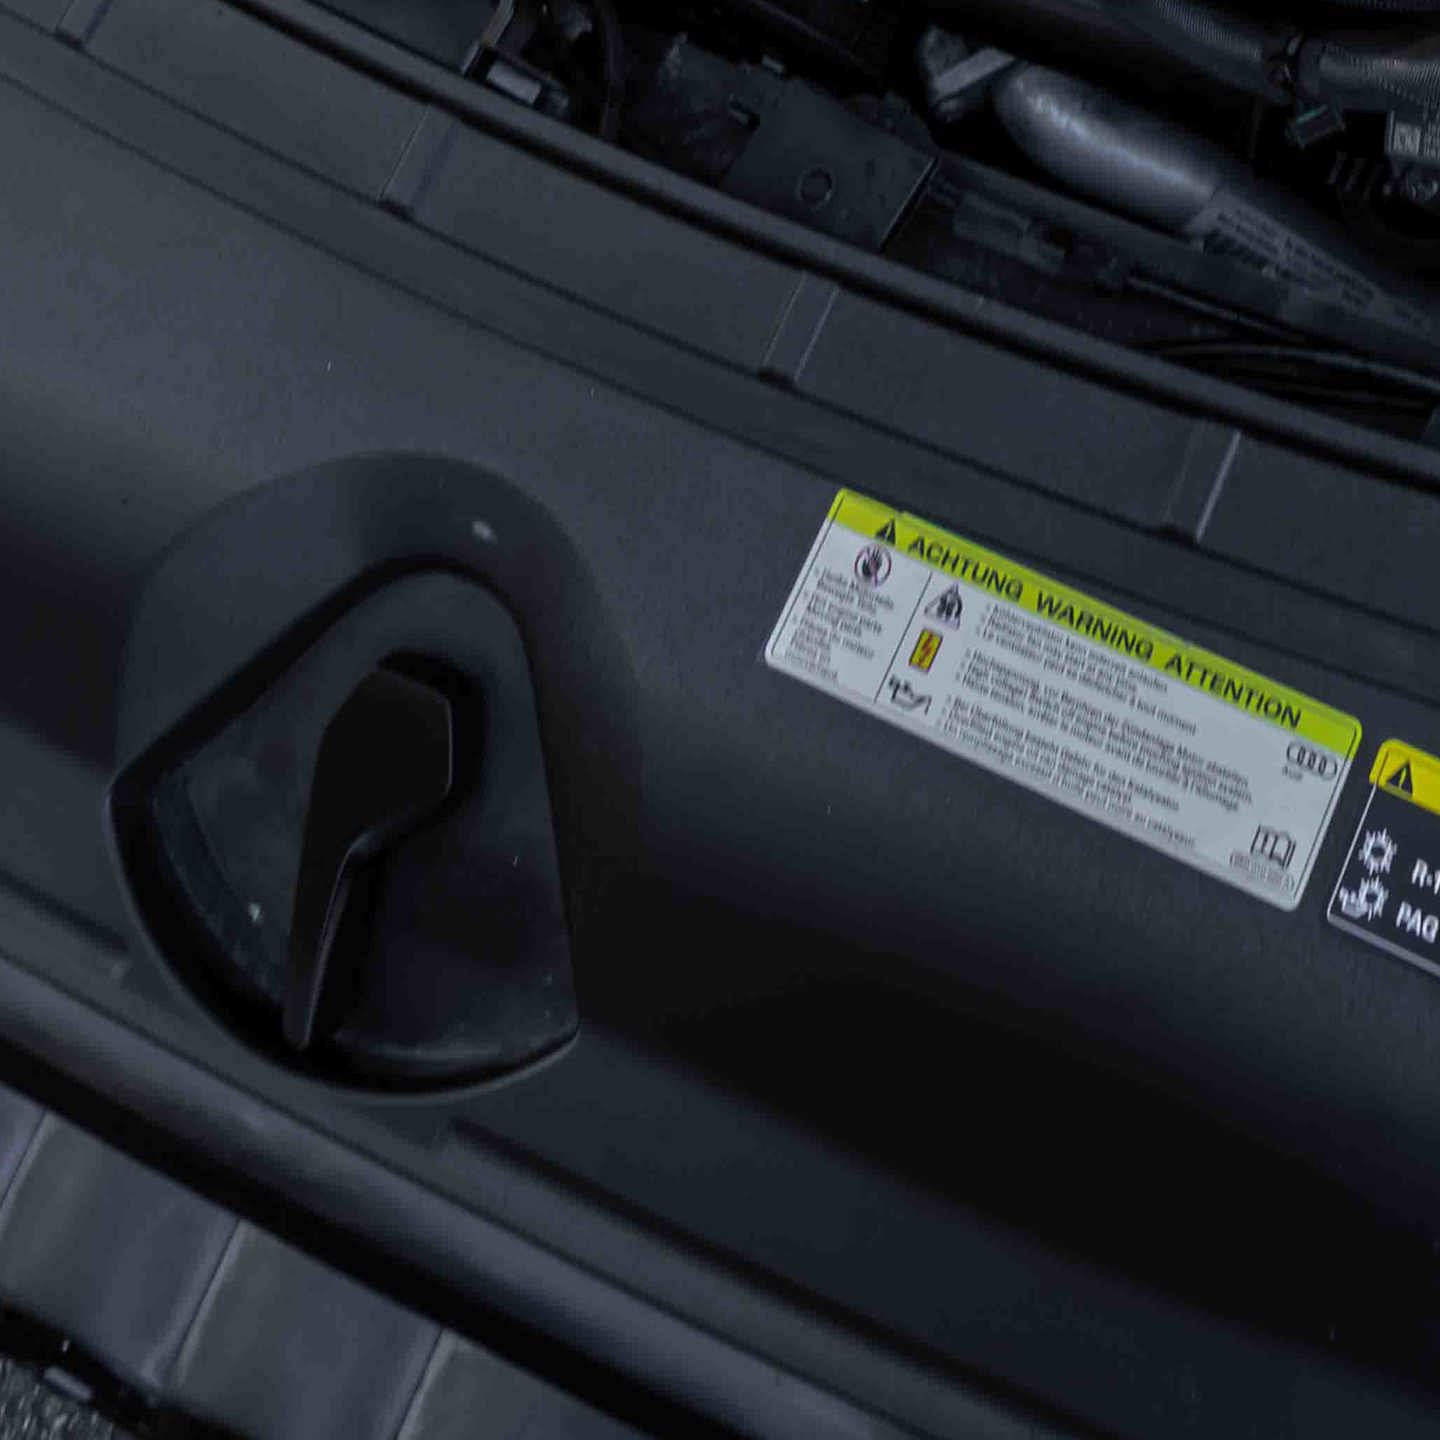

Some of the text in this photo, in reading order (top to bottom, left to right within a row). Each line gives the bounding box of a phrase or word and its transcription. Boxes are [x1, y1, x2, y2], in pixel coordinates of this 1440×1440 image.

[907, 534, 1024, 604] ACHTUNG
[1036, 594, 1154, 660] WARNING
[1165, 656, 1303, 728] ATTENTION
